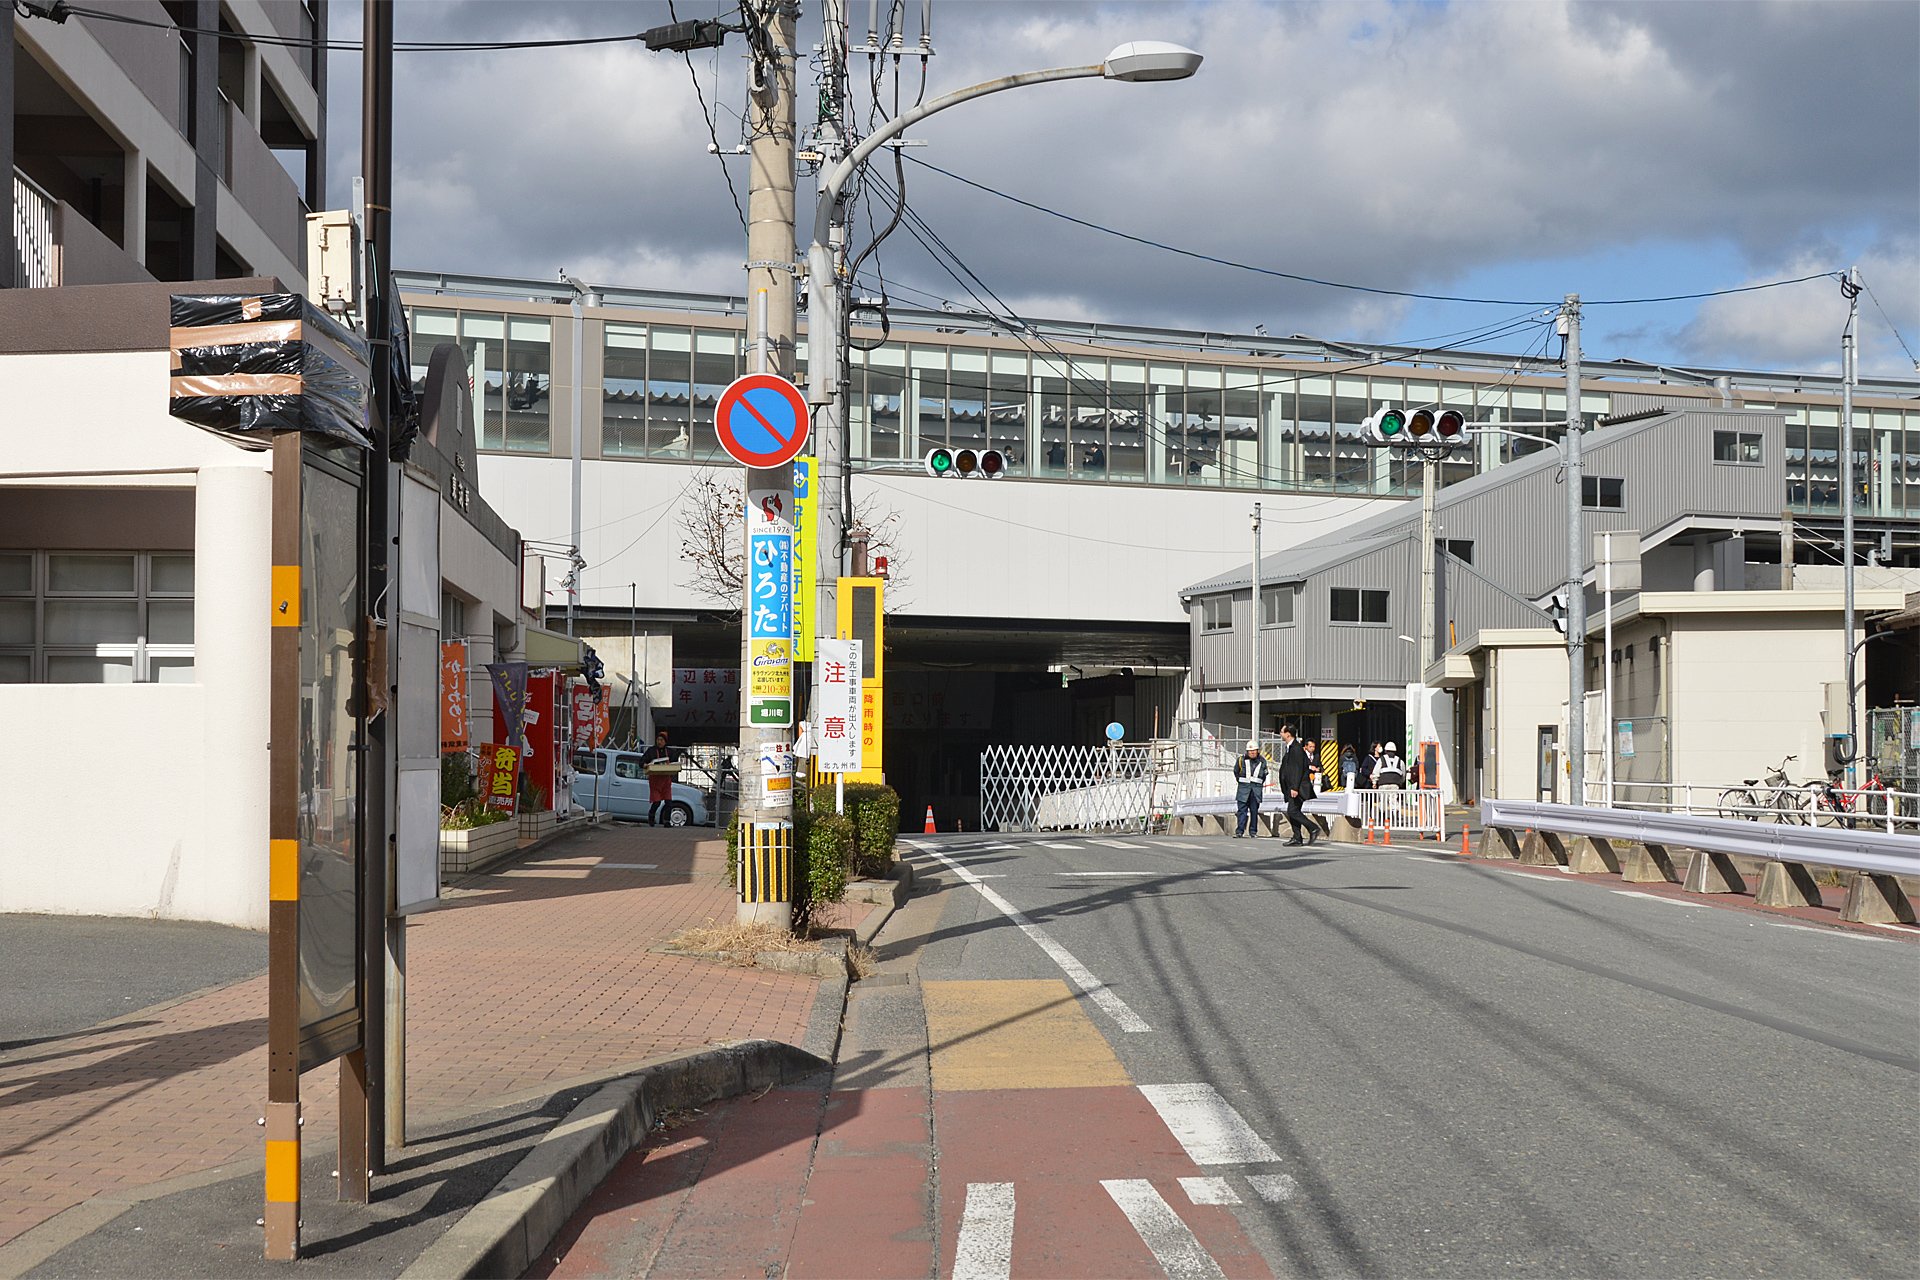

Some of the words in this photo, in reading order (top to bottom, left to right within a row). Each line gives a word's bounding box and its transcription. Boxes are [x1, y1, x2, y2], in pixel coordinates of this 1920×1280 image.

[753, 540, 778, 632] ひろた
[824, 661, 846, 739] 注意
[849, 643, 857, 757] この先工事車両が出入します
[863, 694, 874, 746] 降雨時の
[492, 747, 517, 796] 弁当
[824, 762, 857, 770] 北九州市
